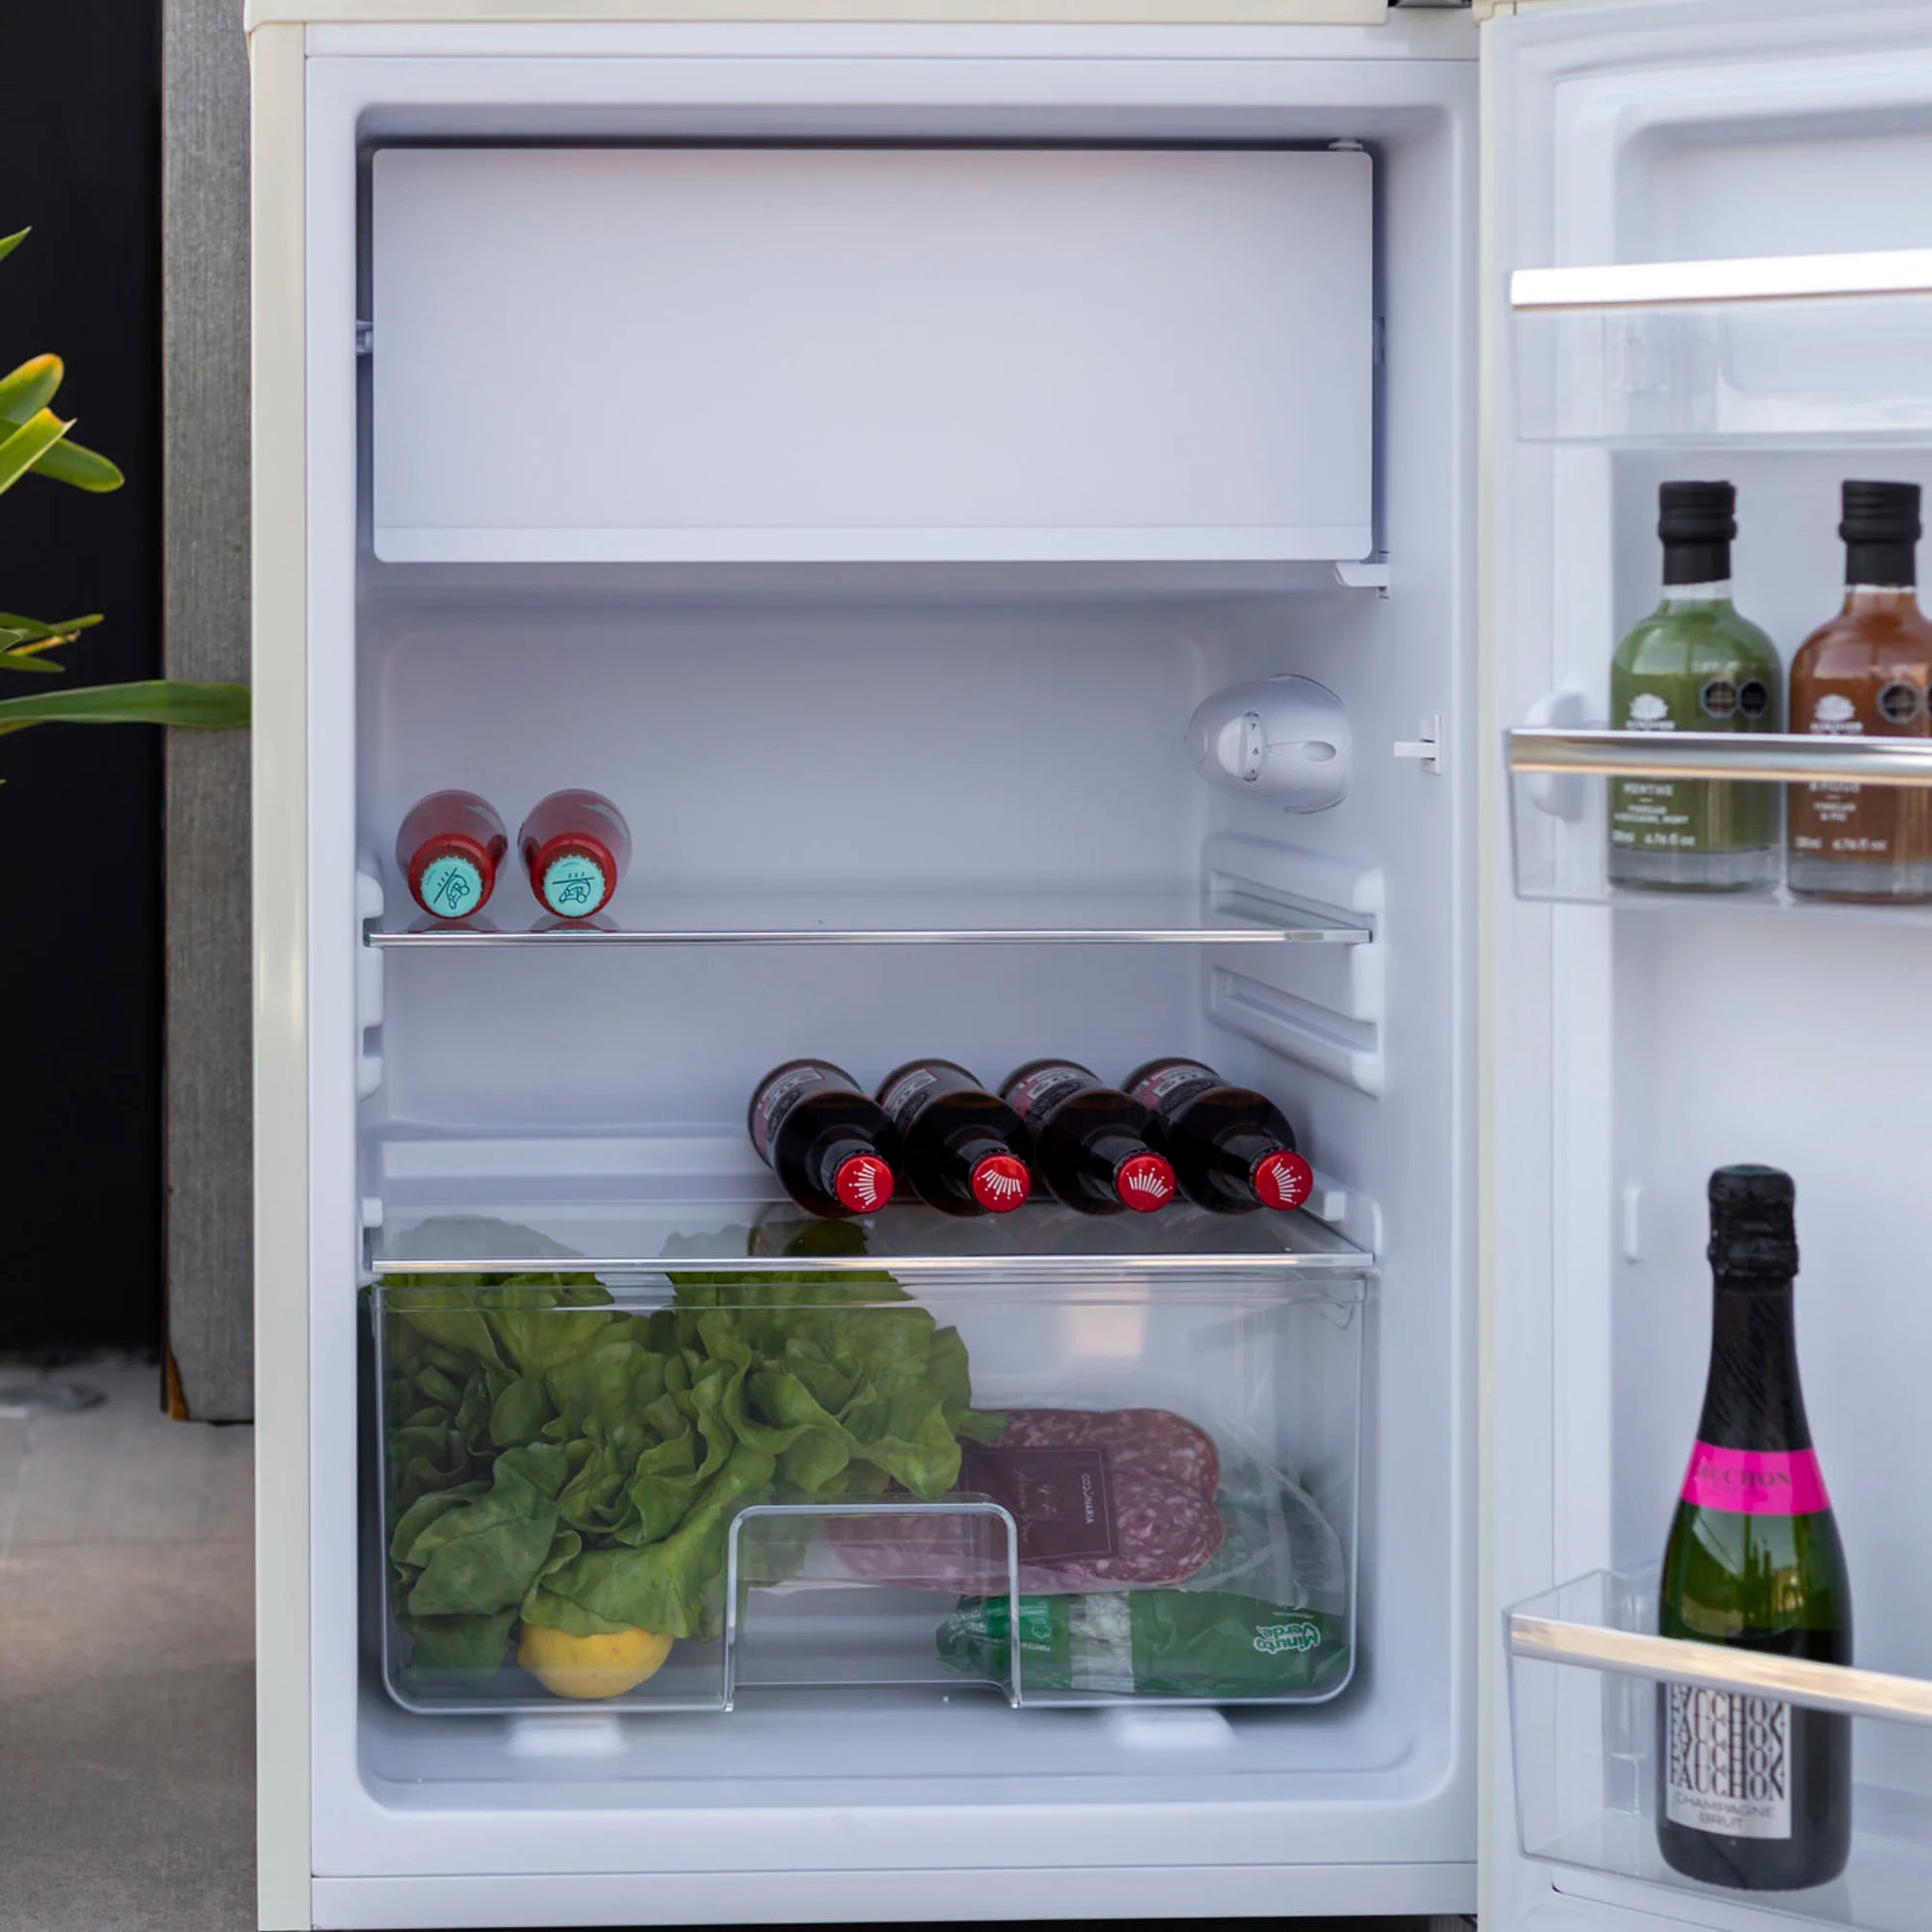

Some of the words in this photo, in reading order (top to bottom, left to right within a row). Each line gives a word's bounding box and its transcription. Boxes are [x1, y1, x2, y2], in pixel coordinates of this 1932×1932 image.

[1254, 1635, 1320, 1655] Minuto
[1676, 1791, 1778, 1819] CHAMPAGNE
[1699, 1812, 1744, 1828] BRUT
